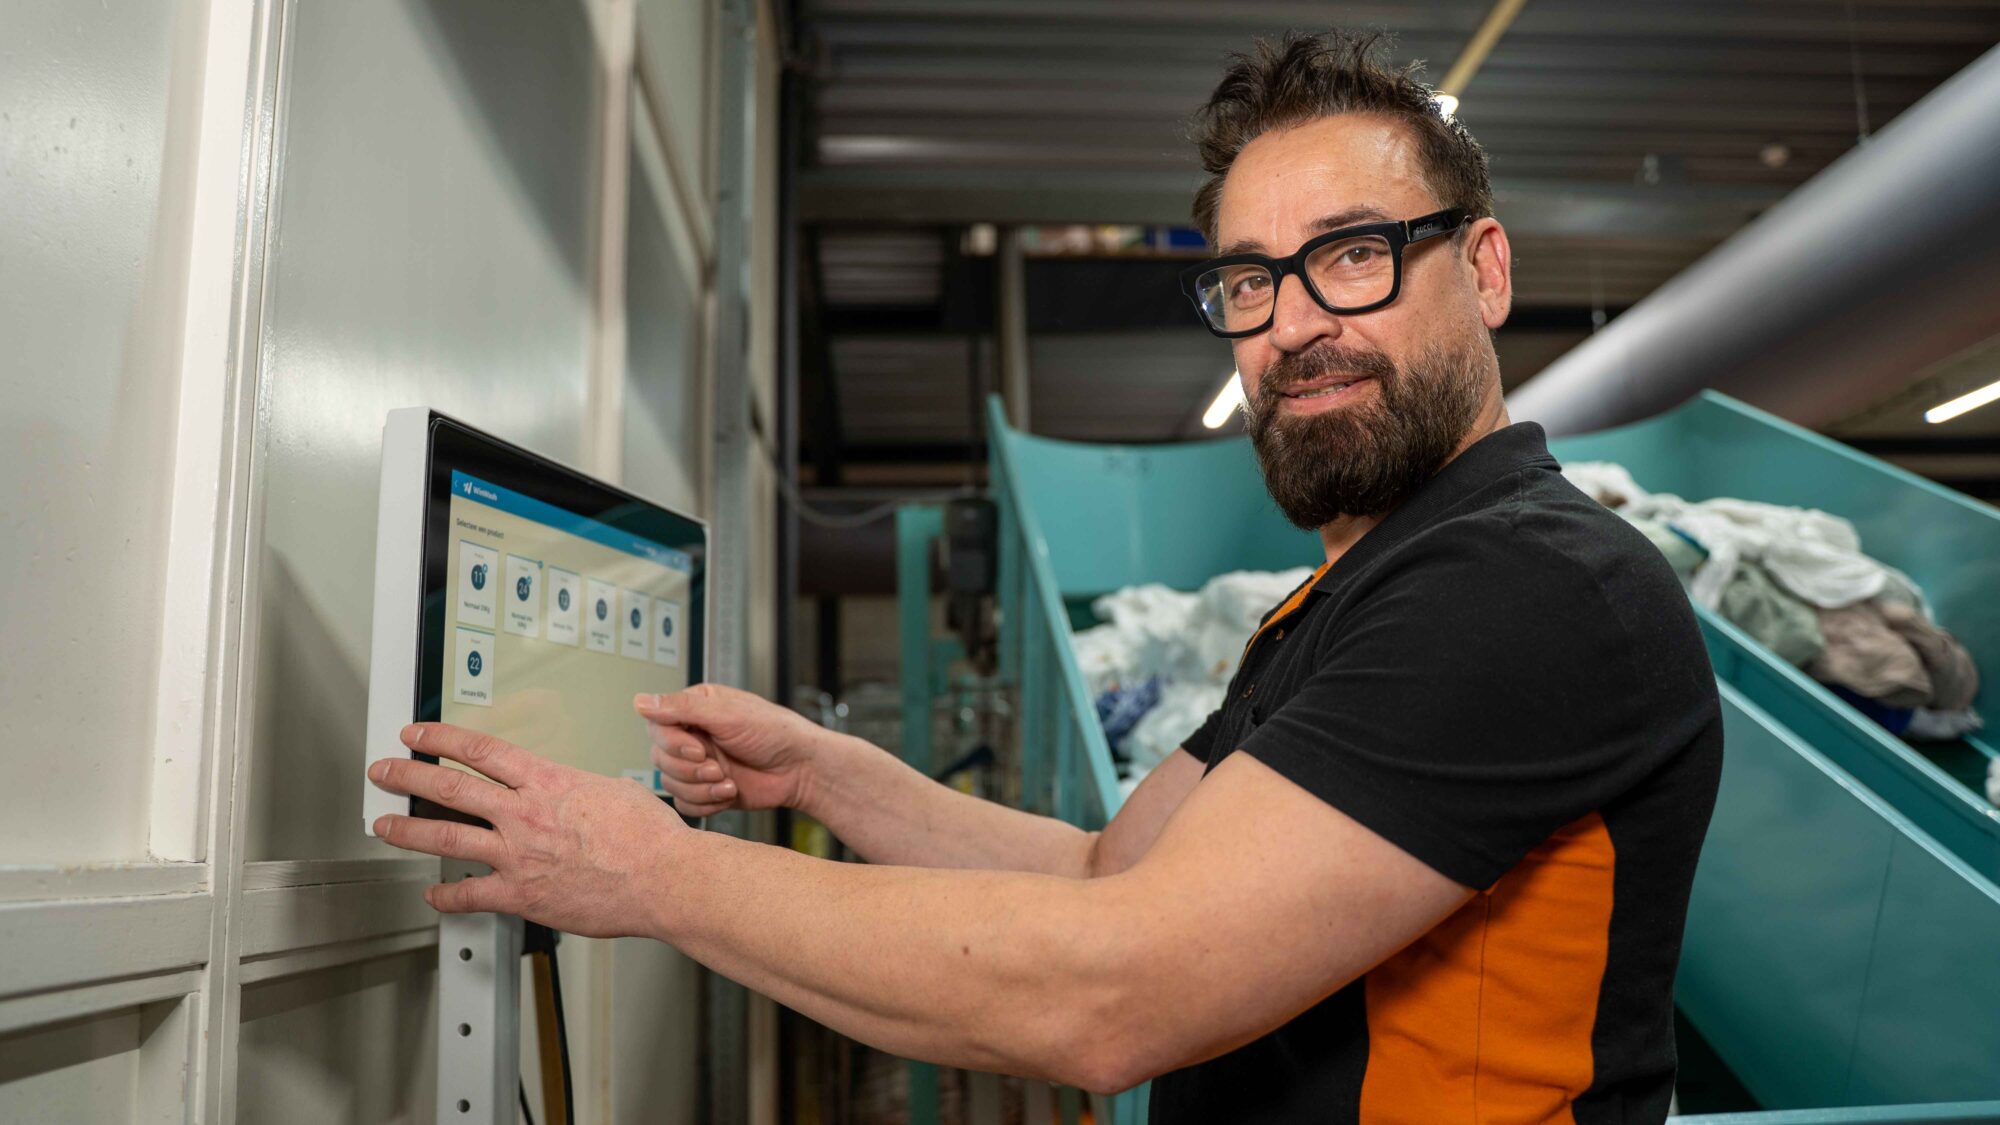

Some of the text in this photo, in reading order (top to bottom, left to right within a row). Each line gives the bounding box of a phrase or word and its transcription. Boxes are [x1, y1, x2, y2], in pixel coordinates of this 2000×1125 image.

[1415, 223, 1433, 235] GUCCI
[473, 571, 483, 584] 11
[518, 582, 528, 595] 24
[469, 656, 480, 670] 22
